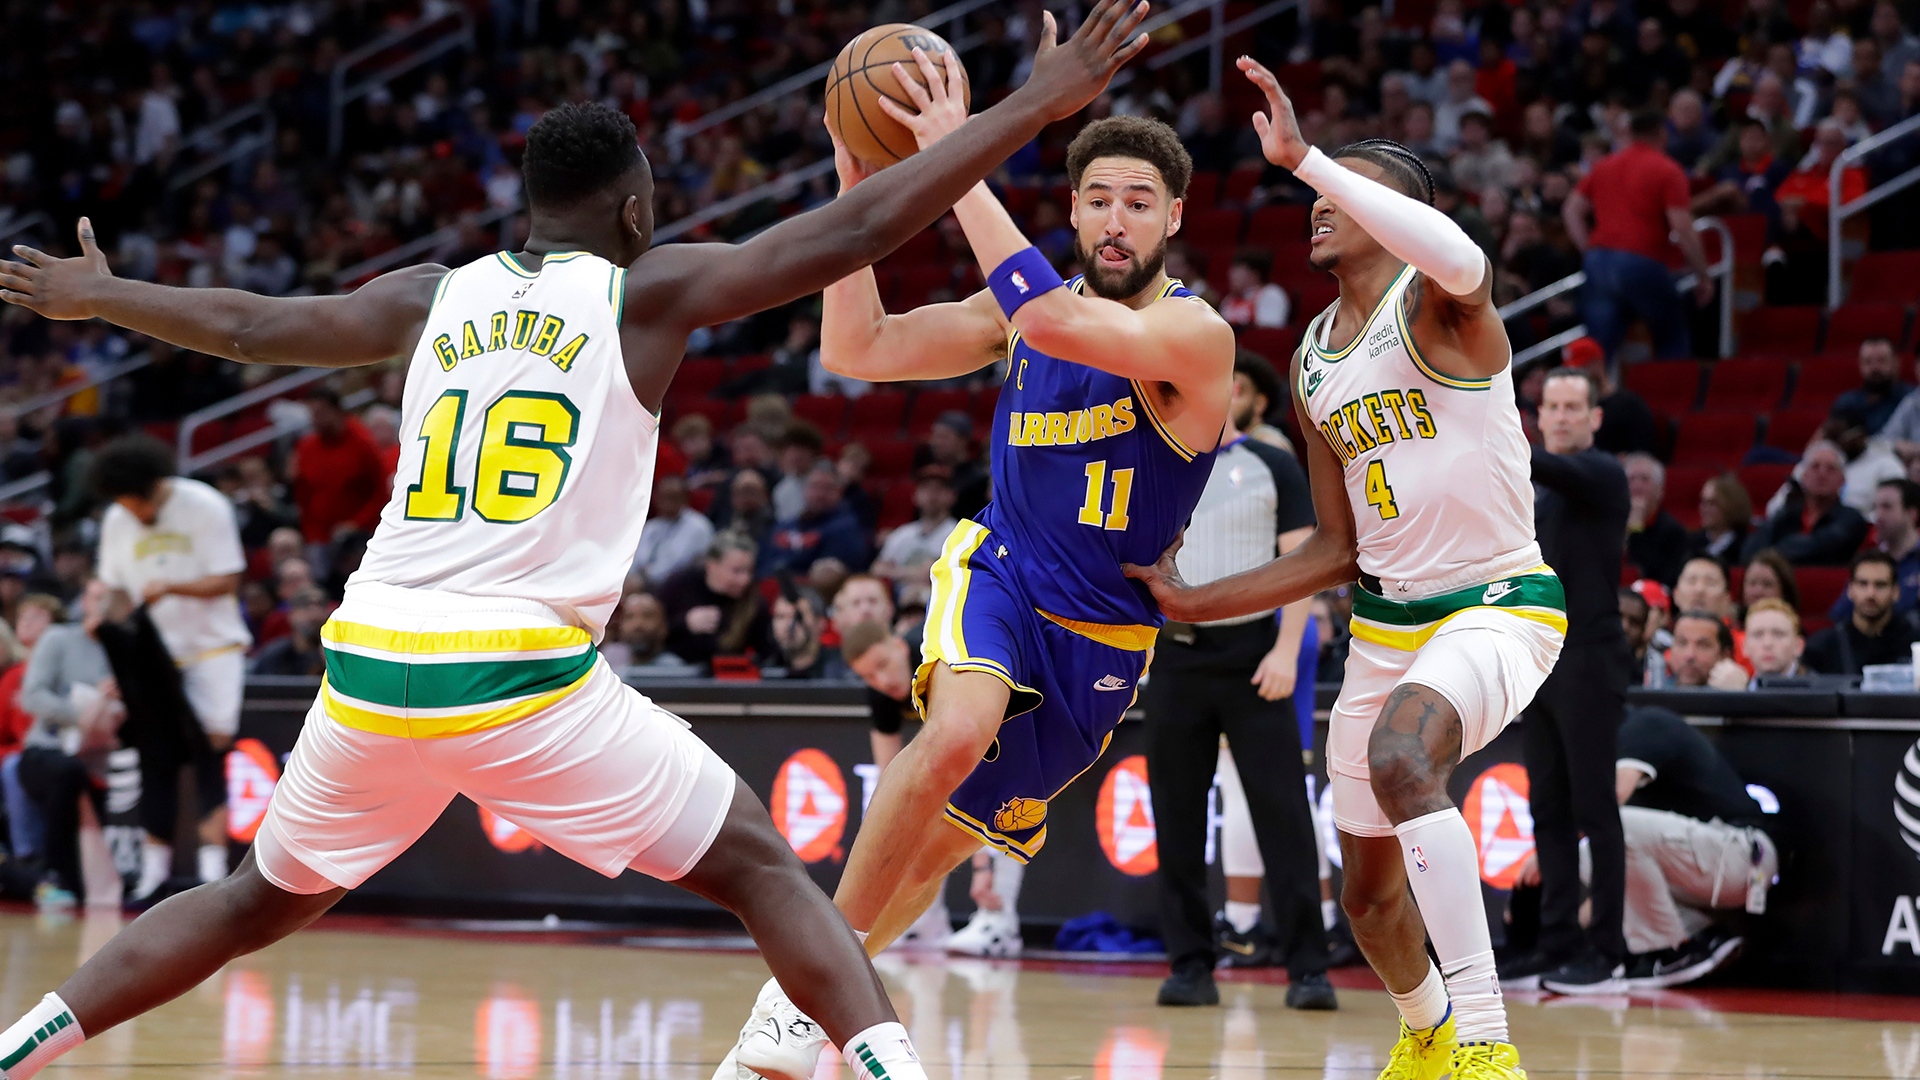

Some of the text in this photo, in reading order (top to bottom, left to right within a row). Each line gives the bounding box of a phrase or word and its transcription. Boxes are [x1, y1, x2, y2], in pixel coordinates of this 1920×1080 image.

[433, 309, 589, 373] GARUBA
[1368, 323, 1395, 346] credit
[1368, 336, 1400, 360] karma
[1016, 358, 1028, 391] C
[1007, 396, 1137, 446] ARRIORS
[1320, 388, 1438, 468] OCKETS
[403, 388, 581, 524] 16
[1077, 460, 1134, 531] 11
[1364, 459, 1400, 520] 4
